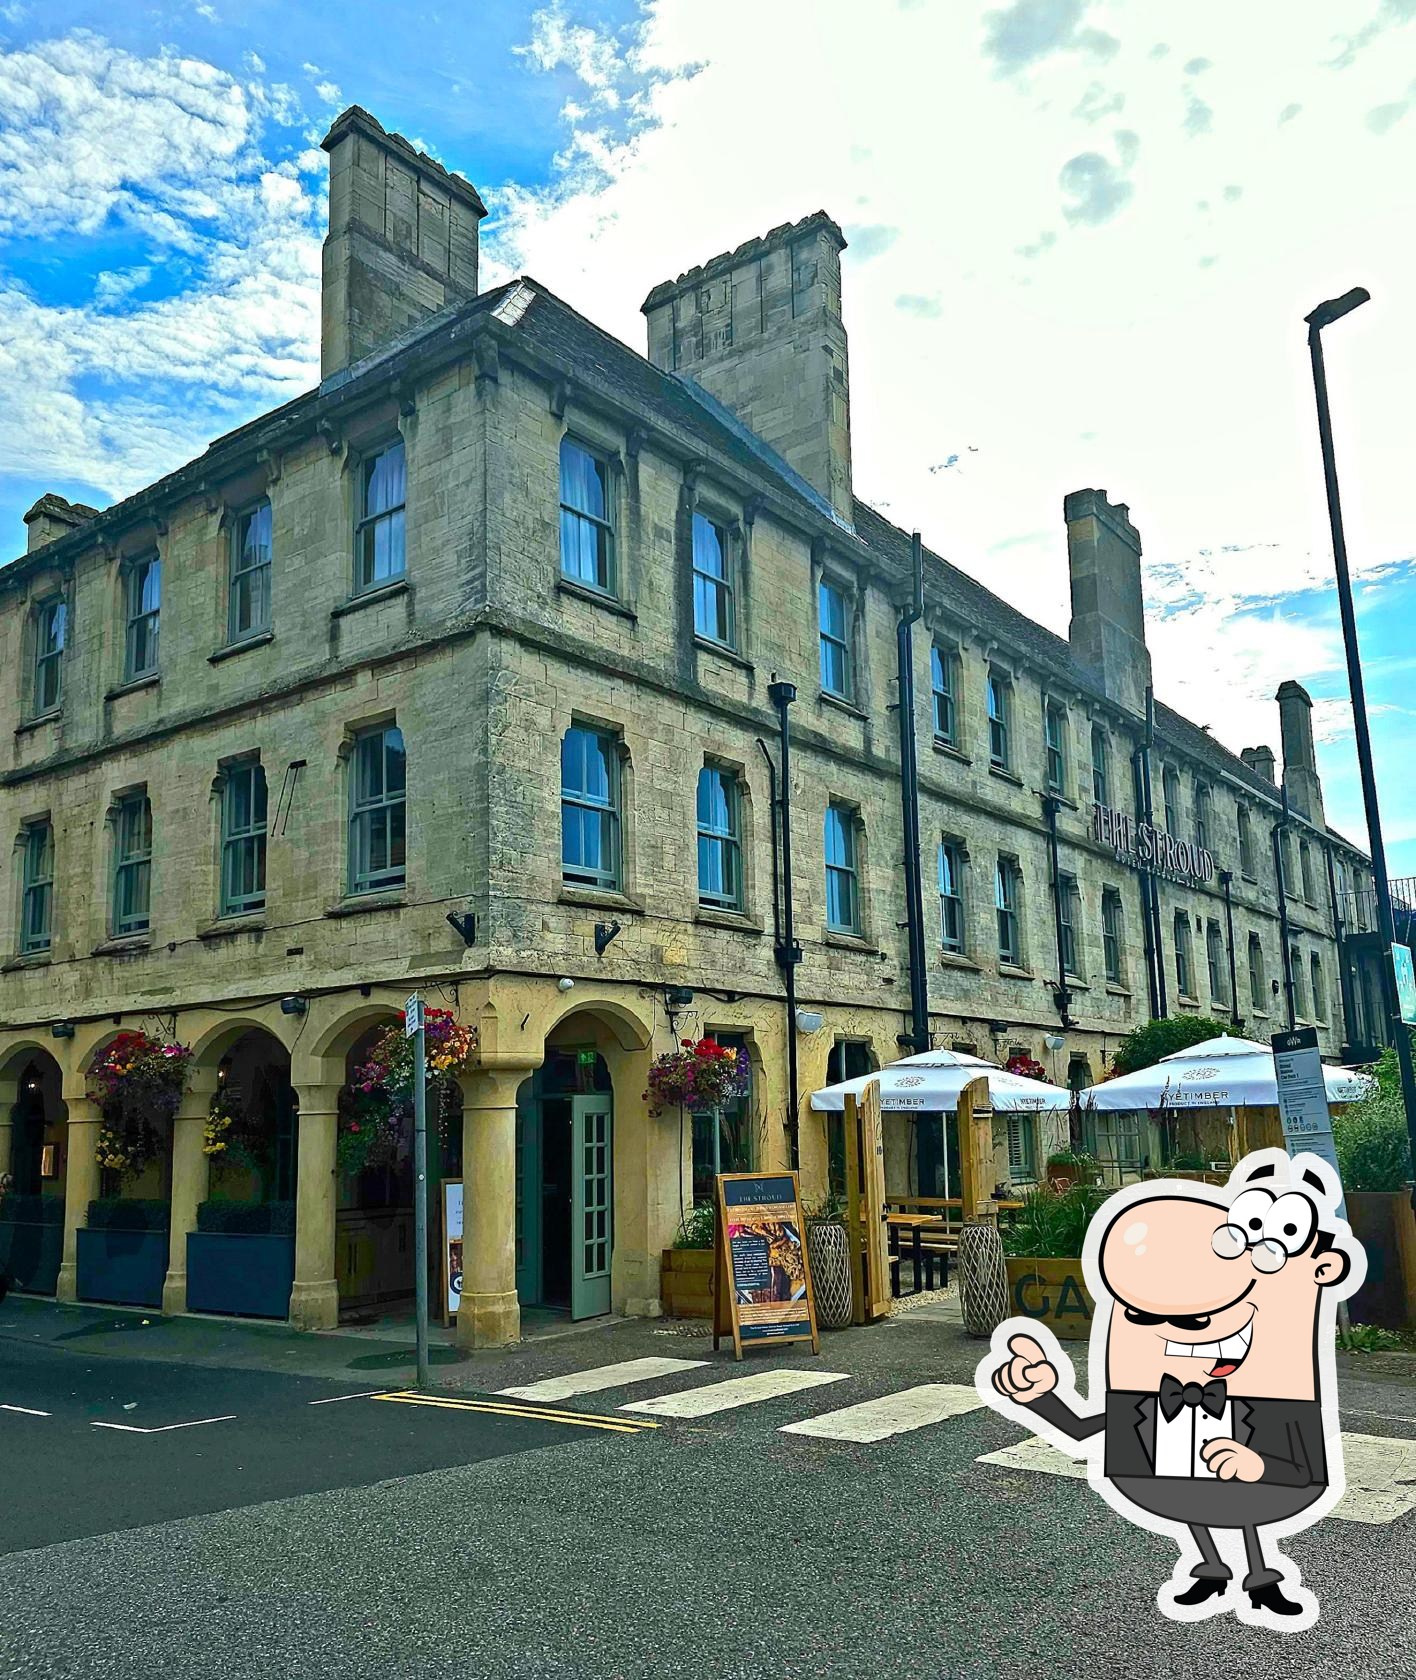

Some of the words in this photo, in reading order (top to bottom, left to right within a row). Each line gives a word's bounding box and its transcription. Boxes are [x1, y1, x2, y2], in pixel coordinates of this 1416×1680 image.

[1092, 802, 1136, 854] THE
[1138, 822, 1215, 882] STROUD
[879, 1098, 925, 1106] YETIMBER
[1014, 1273, 1092, 1319] GA
